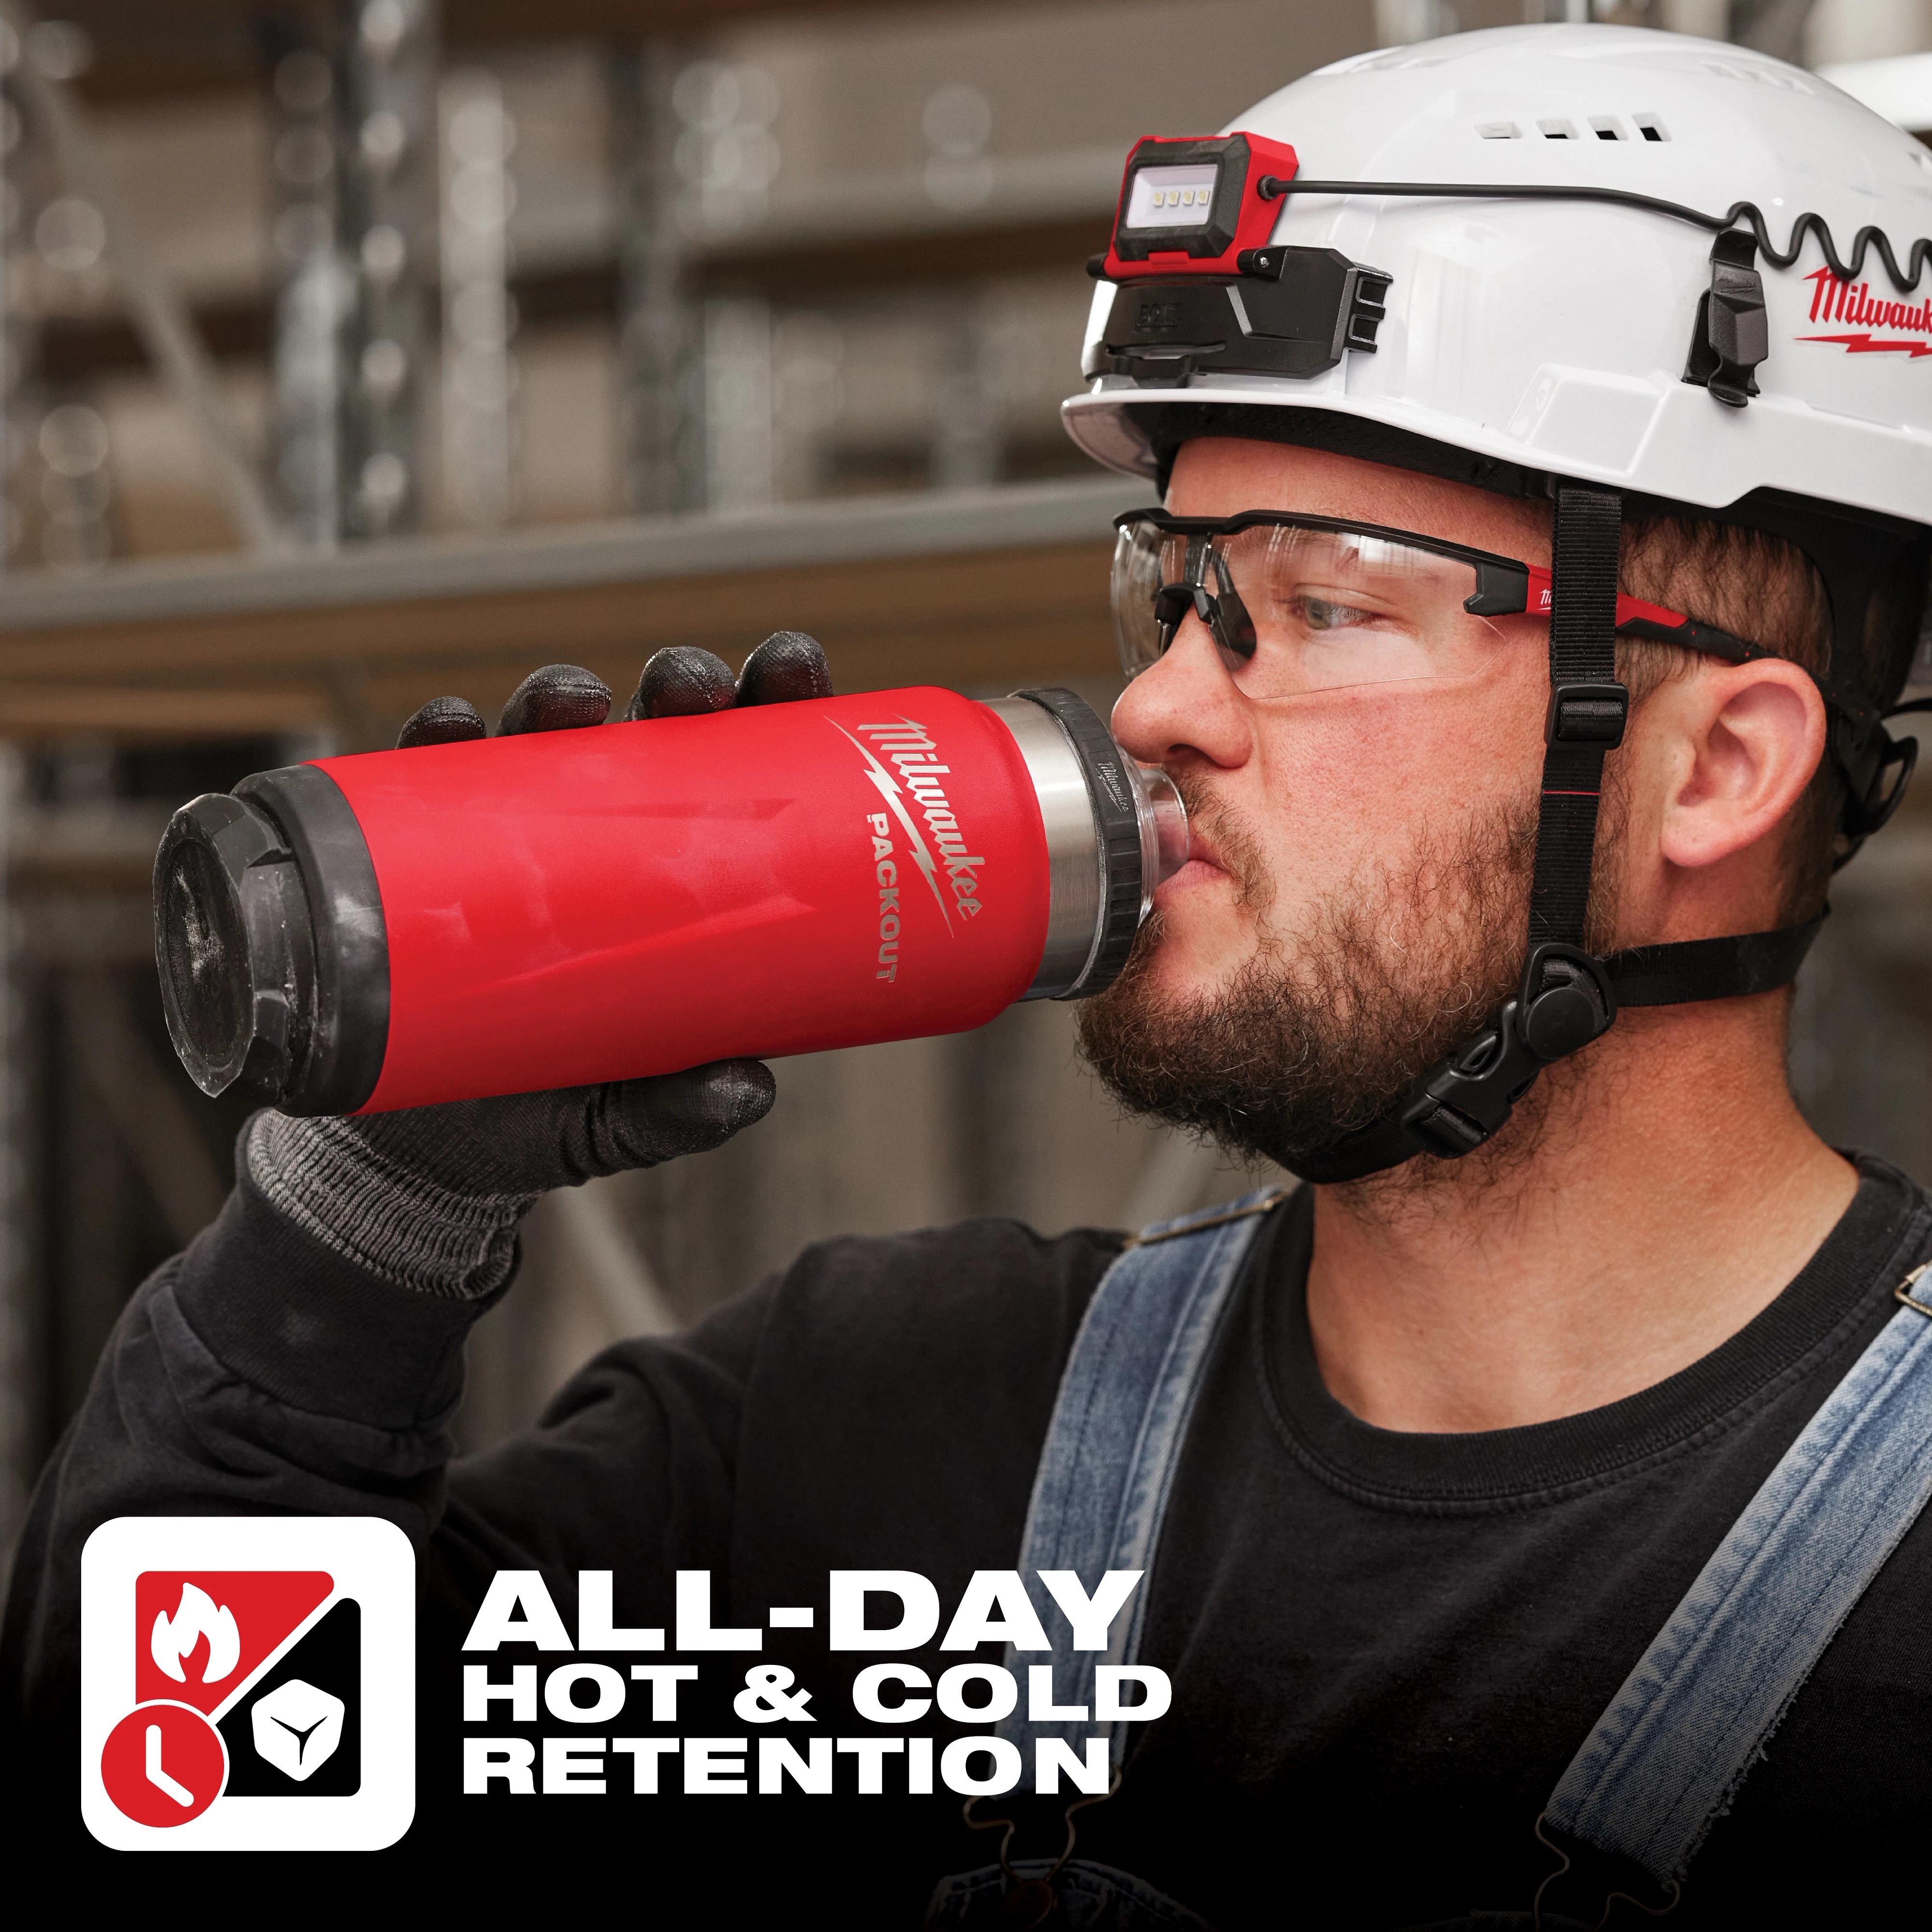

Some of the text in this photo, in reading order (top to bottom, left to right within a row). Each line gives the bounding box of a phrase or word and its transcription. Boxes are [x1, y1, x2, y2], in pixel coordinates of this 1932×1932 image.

[857, 713, 985, 921] Milwaukee
[1097, 760, 1129, 812] Milwaukee
[867, 813, 901, 983] PACKOUT
